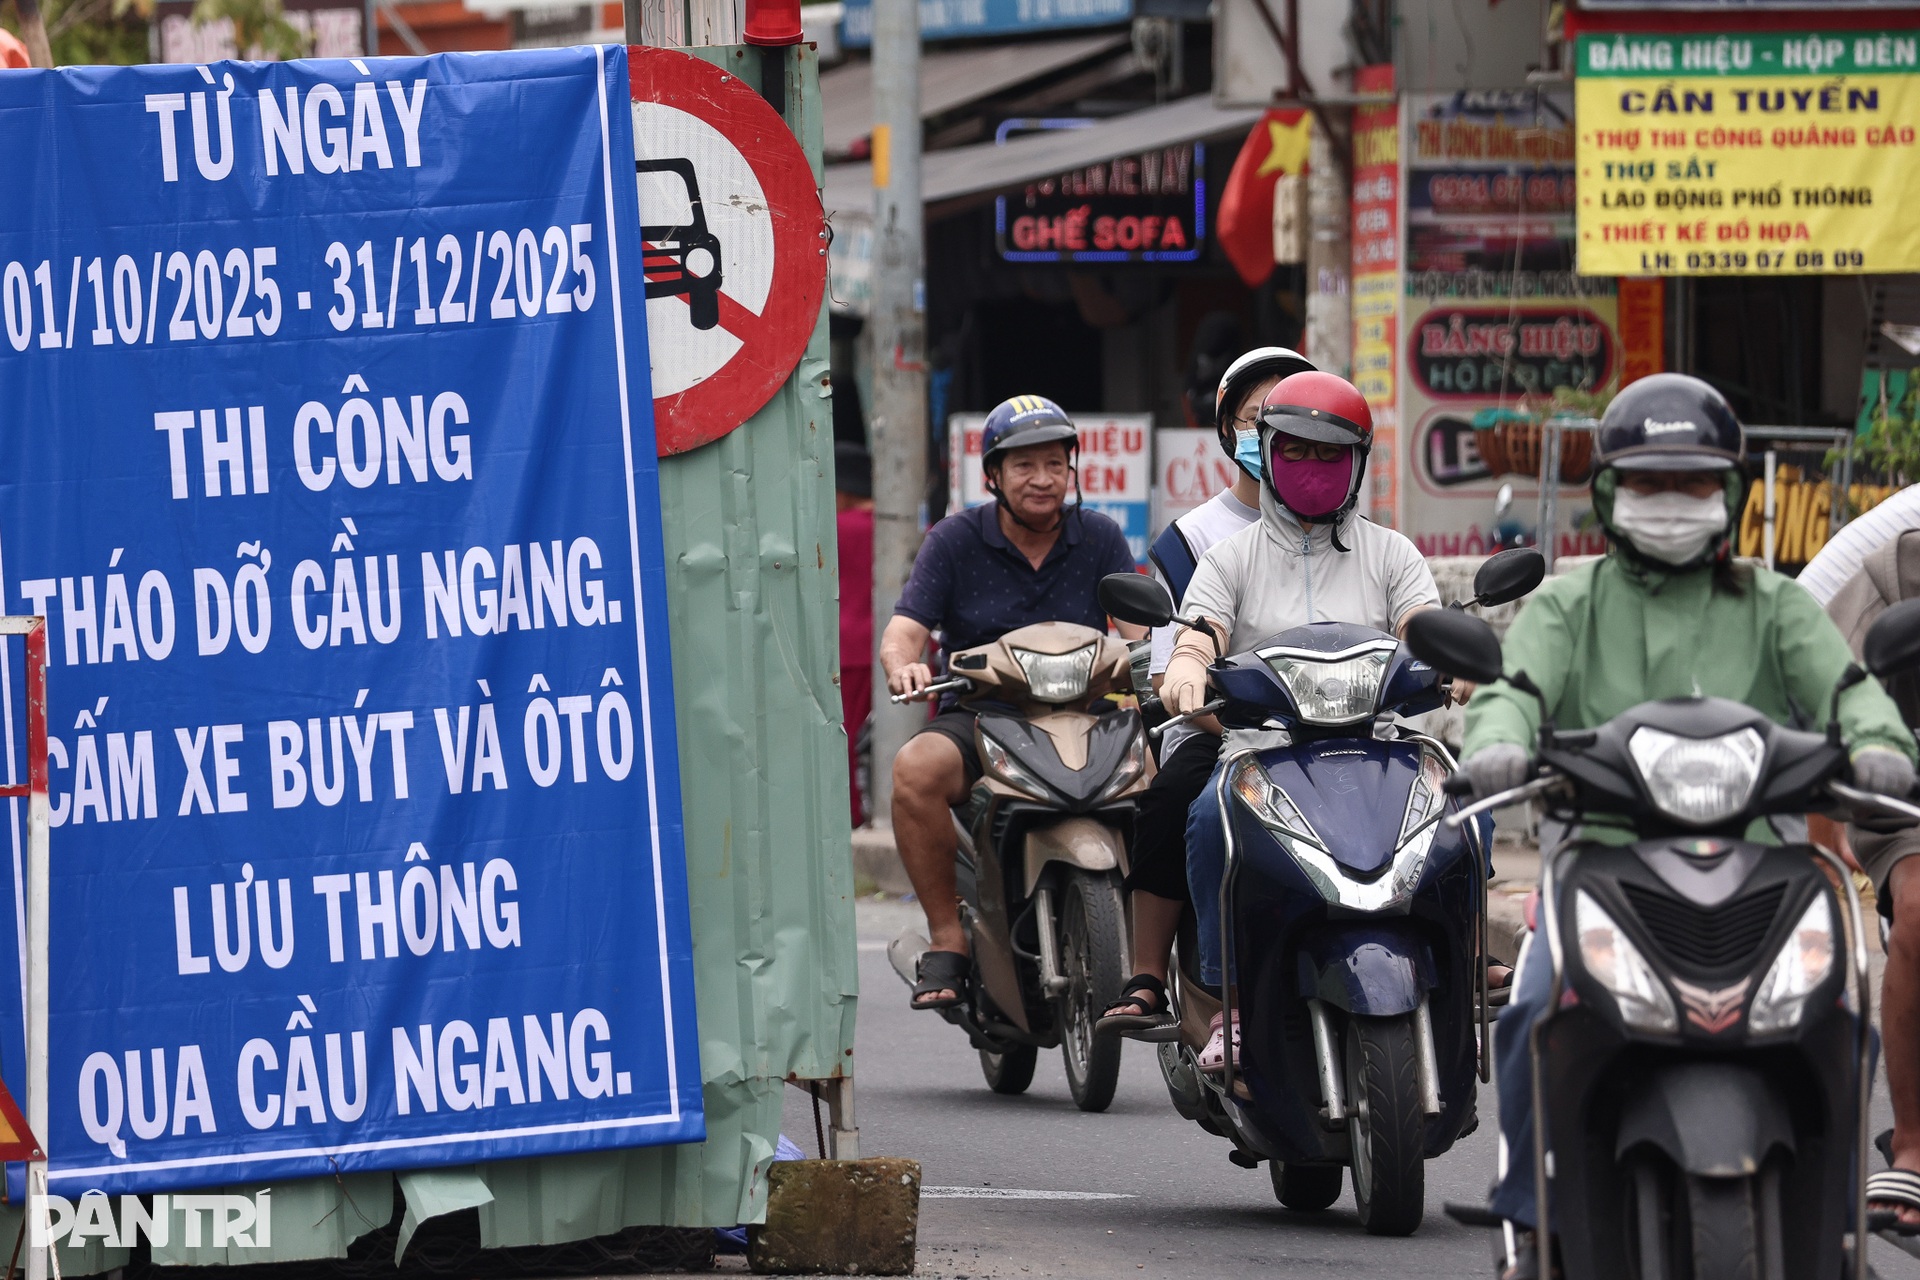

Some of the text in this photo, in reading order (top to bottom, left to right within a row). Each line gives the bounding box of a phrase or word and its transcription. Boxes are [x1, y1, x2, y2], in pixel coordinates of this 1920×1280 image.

[1588, 34, 1673, 71] BẢNG
[1681, 36, 1752, 74] HIỆU
[1783, 34, 1843, 73] HỘP
[1853, 32, 1917, 67] ĐÈN
[1732, 75, 1879, 113] TUYỂN
[145, 60, 428, 182] TỪ NGÀY
[1594, 127, 1640, 151] THỢ
[1650, 129, 1687, 148] THI
[1694, 124, 1764, 148] CÔNG
[1771, 121, 1857, 150] QUẢNG
[1866, 122, 1916, 147] CÁO
[1604, 155, 1717, 184] THỢ SẮT
[1601, 188, 1647, 209] LAO
[1654, 186, 1724, 213] ĐỘNG
[1791, 182, 1875, 209] THÔNG
[1012, 203, 1187, 250] GHẾ SOFA
[1602, 216, 1667, 243] THIẾT
[1676, 215, 1710, 243] KẾ
[1687, 250, 1748, 271] 0339
[1757, 250, 1785, 271] 07
[1796, 250, 1825, 271] 08
[1834, 250, 1865, 270] 09
[4, 247, 282, 352] 01/10/2025
[325, 223, 596, 332] 31/12/2025
[1422, 313, 1516, 357] BẢNG
[1519, 316, 1600, 360] HIỆU
[155, 374, 472, 500] THI CÔNG
[20, 517, 622, 667] THÁO DỠ CẦU NGANG.
[47, 667, 634, 828] CẤM XE BUÝT VÀ ÔTÔ
[173, 842, 521, 975] LƯU THÔNG
[79, 995, 632, 1159] QUA CẦU NGANG.
